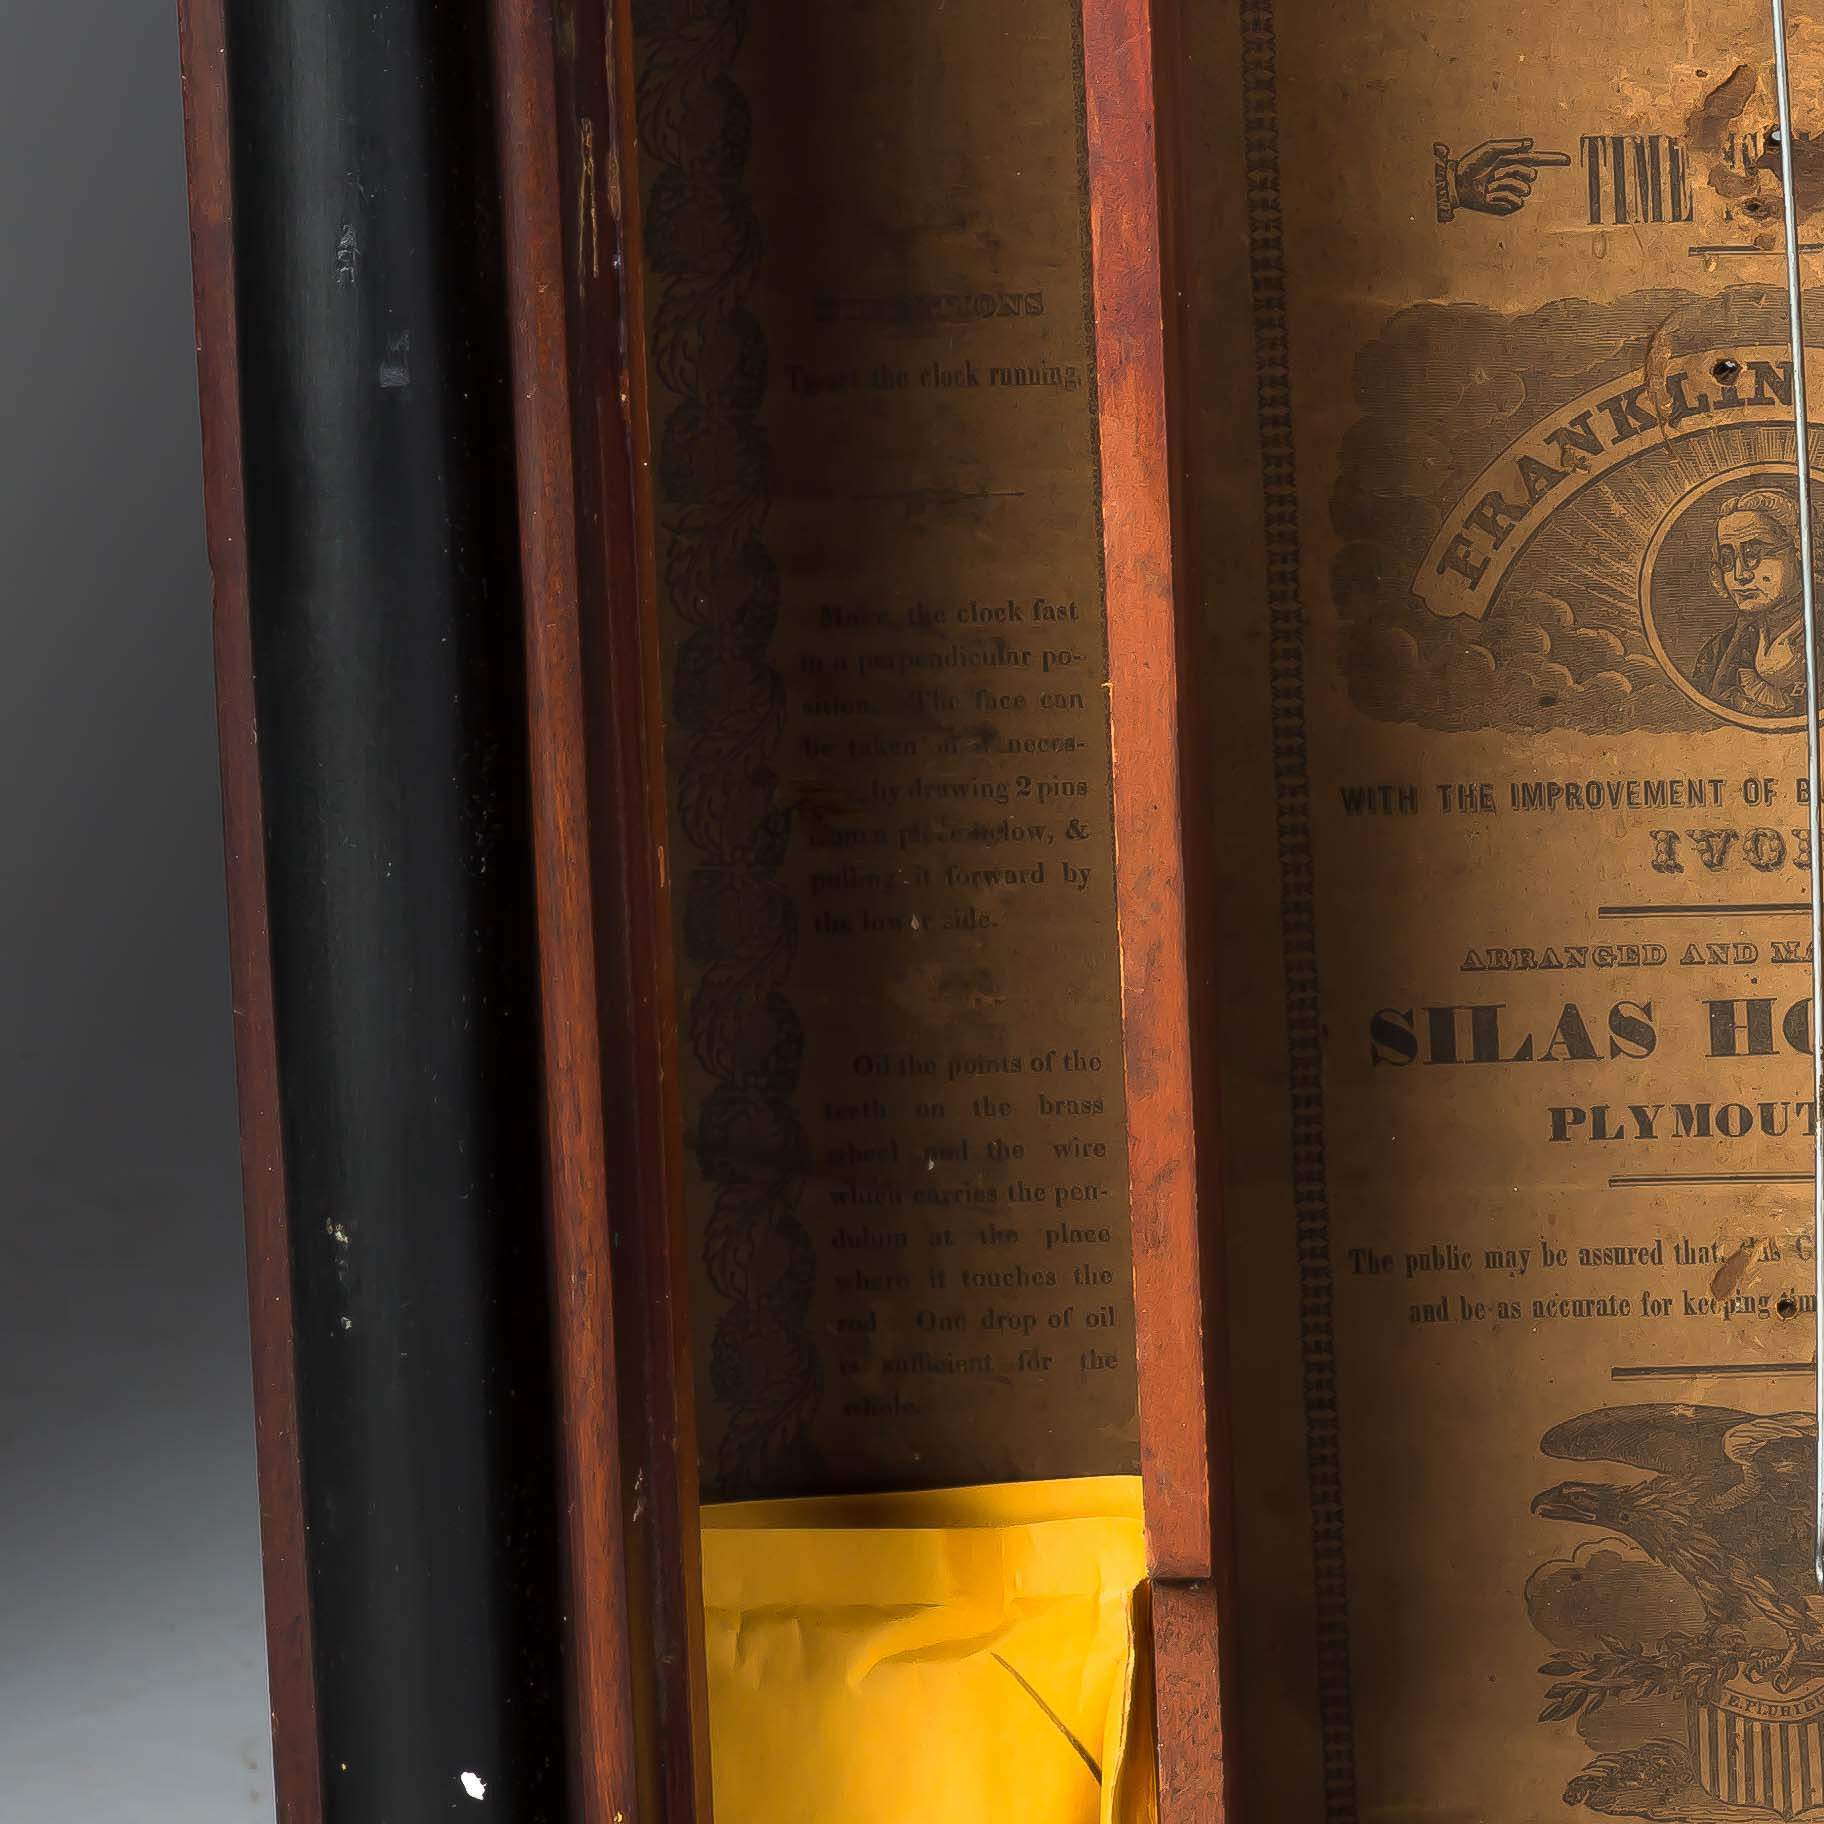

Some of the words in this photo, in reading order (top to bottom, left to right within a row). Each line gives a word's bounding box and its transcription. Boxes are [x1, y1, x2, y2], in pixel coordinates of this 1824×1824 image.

[872, 364, 910, 391] the
[920, 359, 980, 390] clock
[1437, 360, 1796, 592] FRANKLIN
[908, 602, 947, 628] the
[956, 600, 1024, 624] clock
[1031, 598, 1079, 624] fast
[1041, 648, 1085, 674] po-
[974, 687, 1026, 711] face
[1039, 692, 1085, 710] can
[848, 733, 918, 757] taken
[909, 775, 1009, 807] drawing
[1015, 775, 1033, 798] 2
[1037, 777, 1088, 806] pins
[1341, 785, 1419, 815] WITH
[1438, 781, 1497, 813] THE
[1511, 778, 1727, 813] IMPROVEMENT
[1744, 776, 1780, 808] OF
[1064, 817, 1090, 842] &
[944, 861, 1045, 887] forward
[1062, 861, 1092, 891] by
[1460, 942, 1669, 972] ARRANGED
[1681, 941, 1761, 966] AND
[1370, 999, 1660, 1068] SILAS
[852, 1054, 890, 1077] Oil
[947, 1053, 1023, 1081] points
[1030, 1051, 1058, 1073] of
[1062, 1050, 1103, 1073] the
[914, 1100, 946, 1119] on
[972, 1096, 1013, 1117] the
[1038, 1093, 1105, 1116] brass
[986, 1137, 1025, 1160] the
[1052, 1135, 1107, 1160] wire
[1007, 1180, 1047, 1203] the
[1053, 1182, 1109, 1209] pen-
[928, 1228, 955, 1247] at
[974, 1224, 1019, 1246] the
[1044, 1223, 1112, 1249] place
[1347, 1246, 1394, 1277] The
[1406, 1243, 1474, 1279] public
[1485, 1247, 1533, 1279] may
[1541, 1241, 1570, 1268] be
[1579, 1239, 1665, 1268] assured
[928, 1267, 946, 1289] it
[960, 1265, 1057, 1288] touches
[1073, 1264, 1113, 1286] the
[915, 1310, 967, 1331] One
[980, 1307, 1039, 1336] drop
[1047, 1307, 1074, 1328] of
[1085, 1305, 1115, 1328] oil
[1410, 1297, 1451, 1326] and
[1461, 1295, 1487, 1323] be
[1497, 1299, 1524, 1321] as
[1532, 1295, 1633, 1320] accurate
[1640, 1291, 1675, 1318] for
[1017, 1347, 1054, 1372] for
[1079, 1348, 1119, 1371] the
